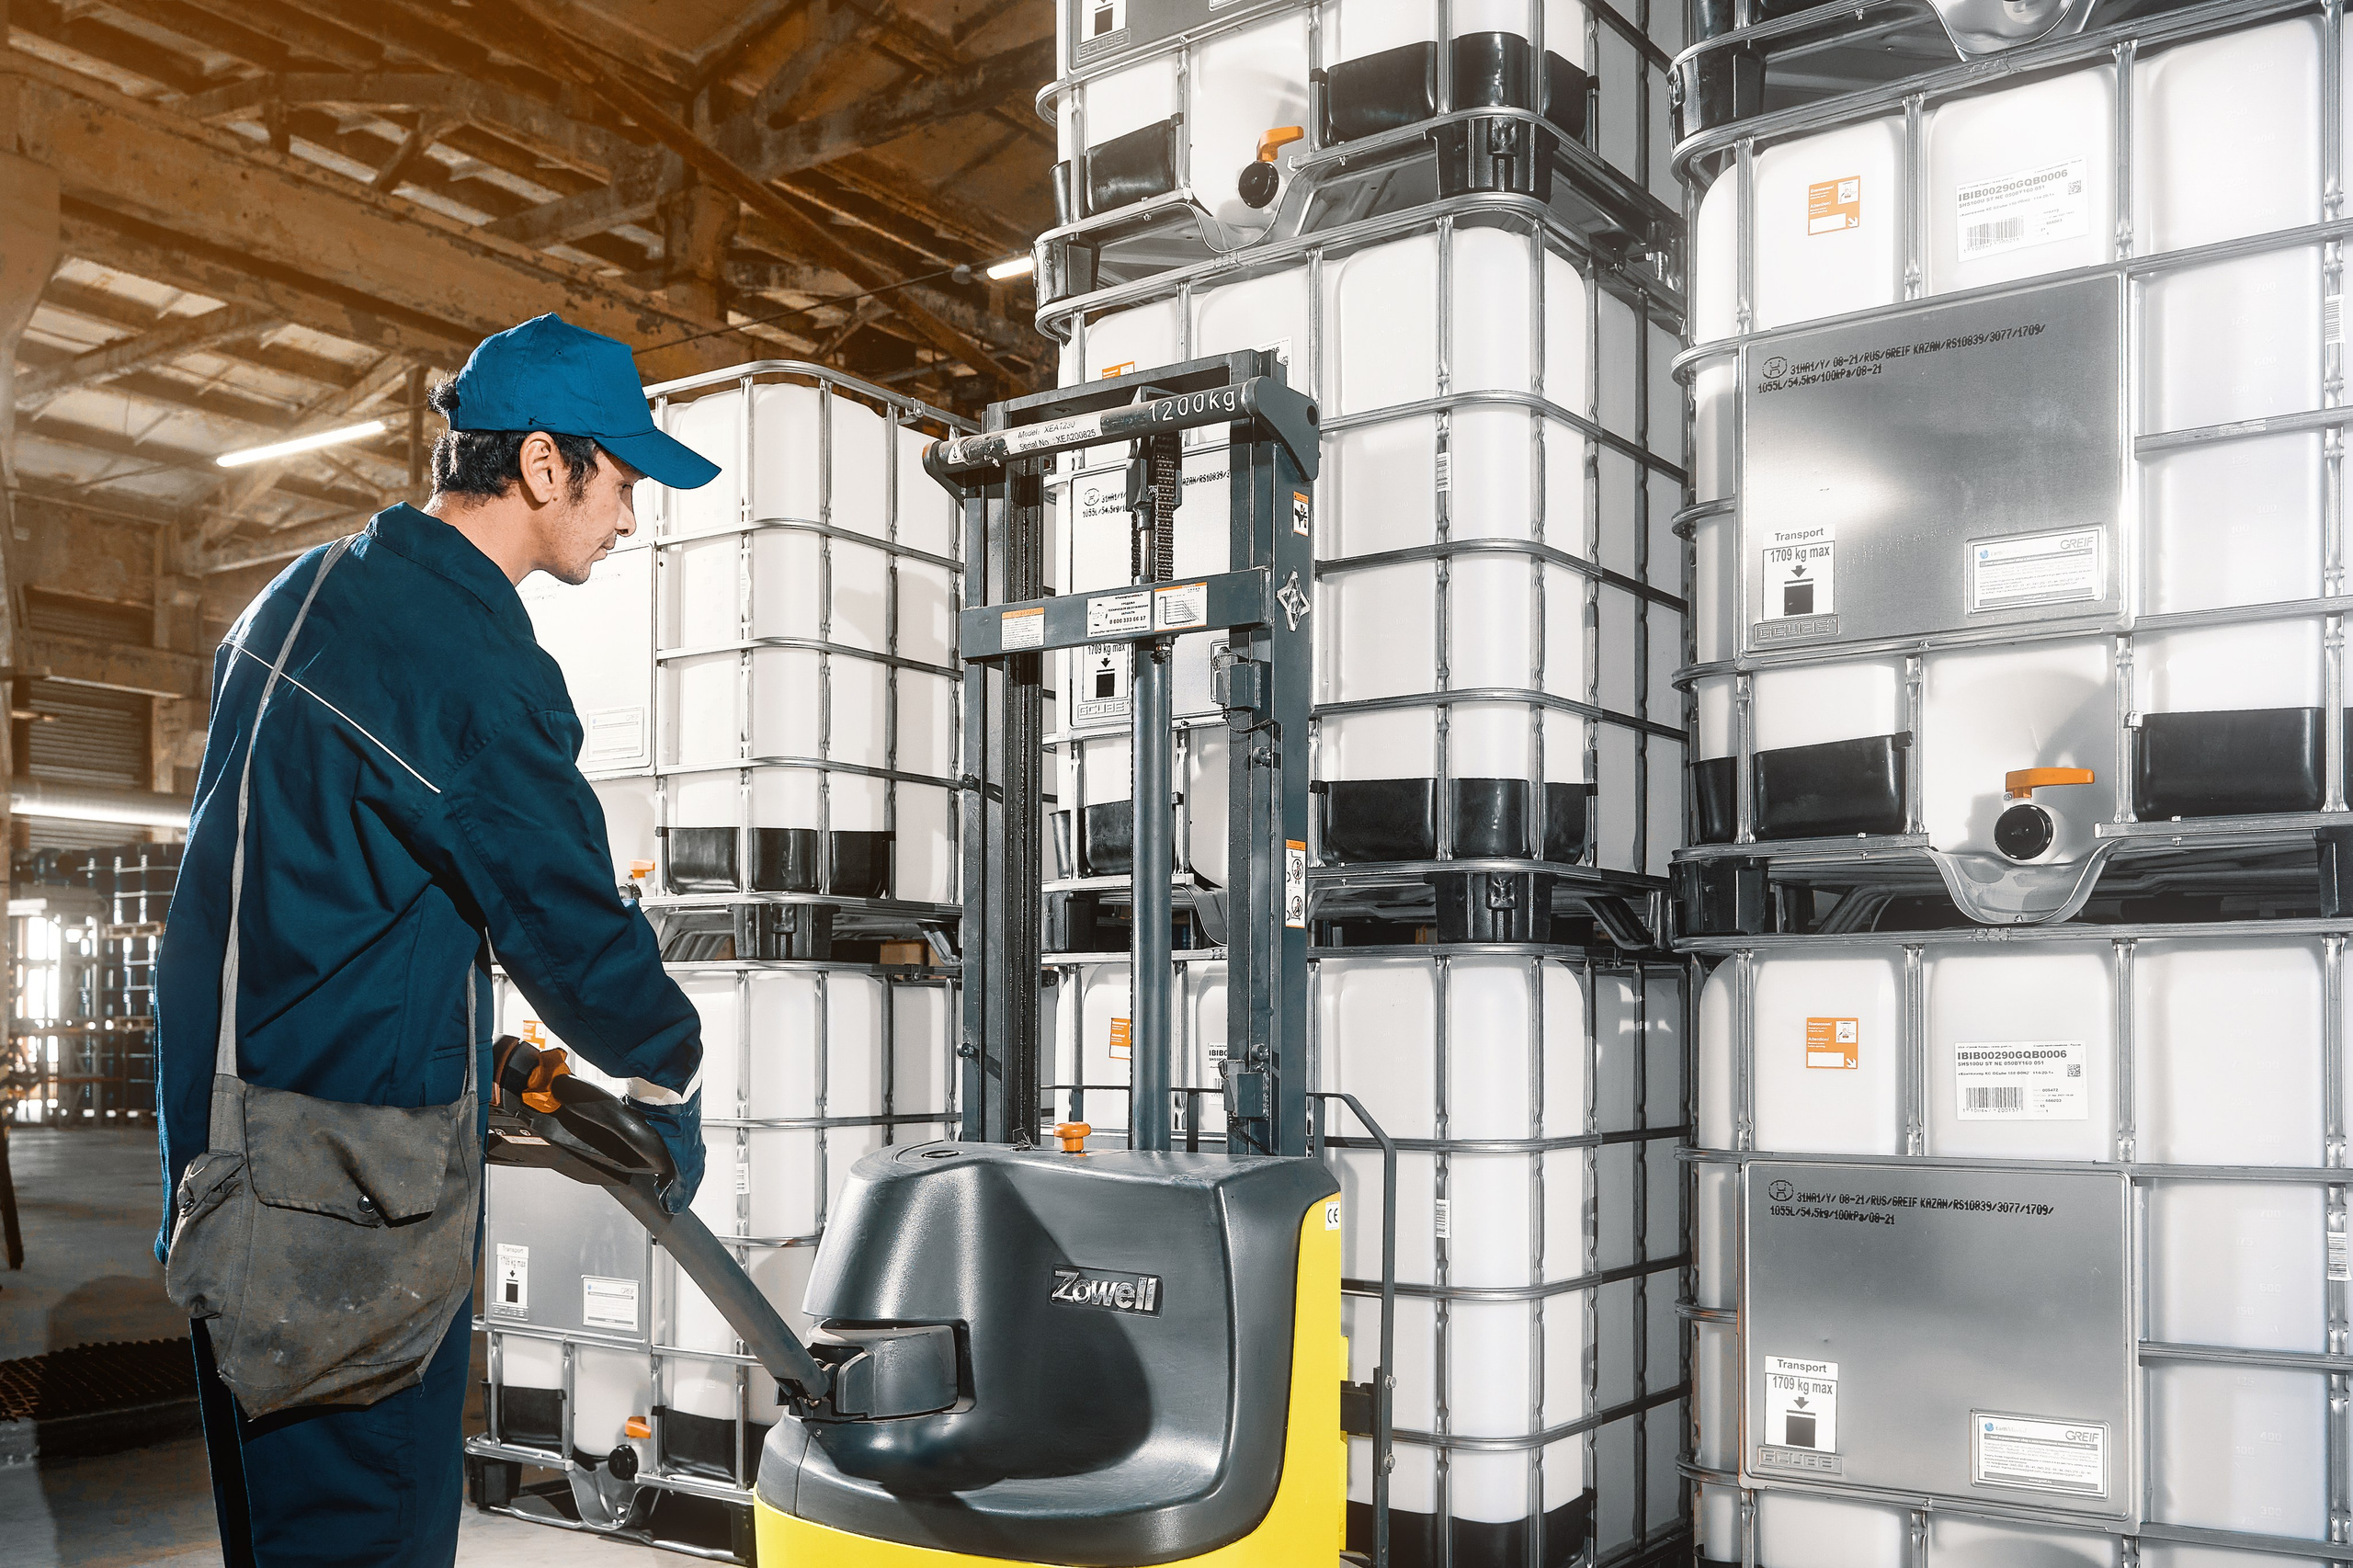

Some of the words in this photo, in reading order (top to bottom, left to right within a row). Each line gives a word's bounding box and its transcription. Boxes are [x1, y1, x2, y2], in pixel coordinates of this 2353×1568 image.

[1958, 169, 2068, 201] IBIB00290GQB0006
[1148, 390, 1236, 422] 1200kg
[1018, 441, 1039, 451] Serial
[1775, 527, 1824, 541] Transport
[2060, 536, 2095, 550] GREIF
[1770, 548, 1792, 563] 1709
[1795, 547, 1807, 562] kg
[1809, 545, 1831, 558] max
[1957, 1050, 2067, 1061] IBIB00290GQB0006
[1051, 1268, 1159, 1312] Zowell
[1777, 1358, 1827, 1373] Transport
[1772, 1375, 1795, 1390] 1709
[1797, 1378, 1810, 1395] kg
[1812, 1382, 1833, 1394] max
[2064, 1430, 2100, 1443] GREIF
